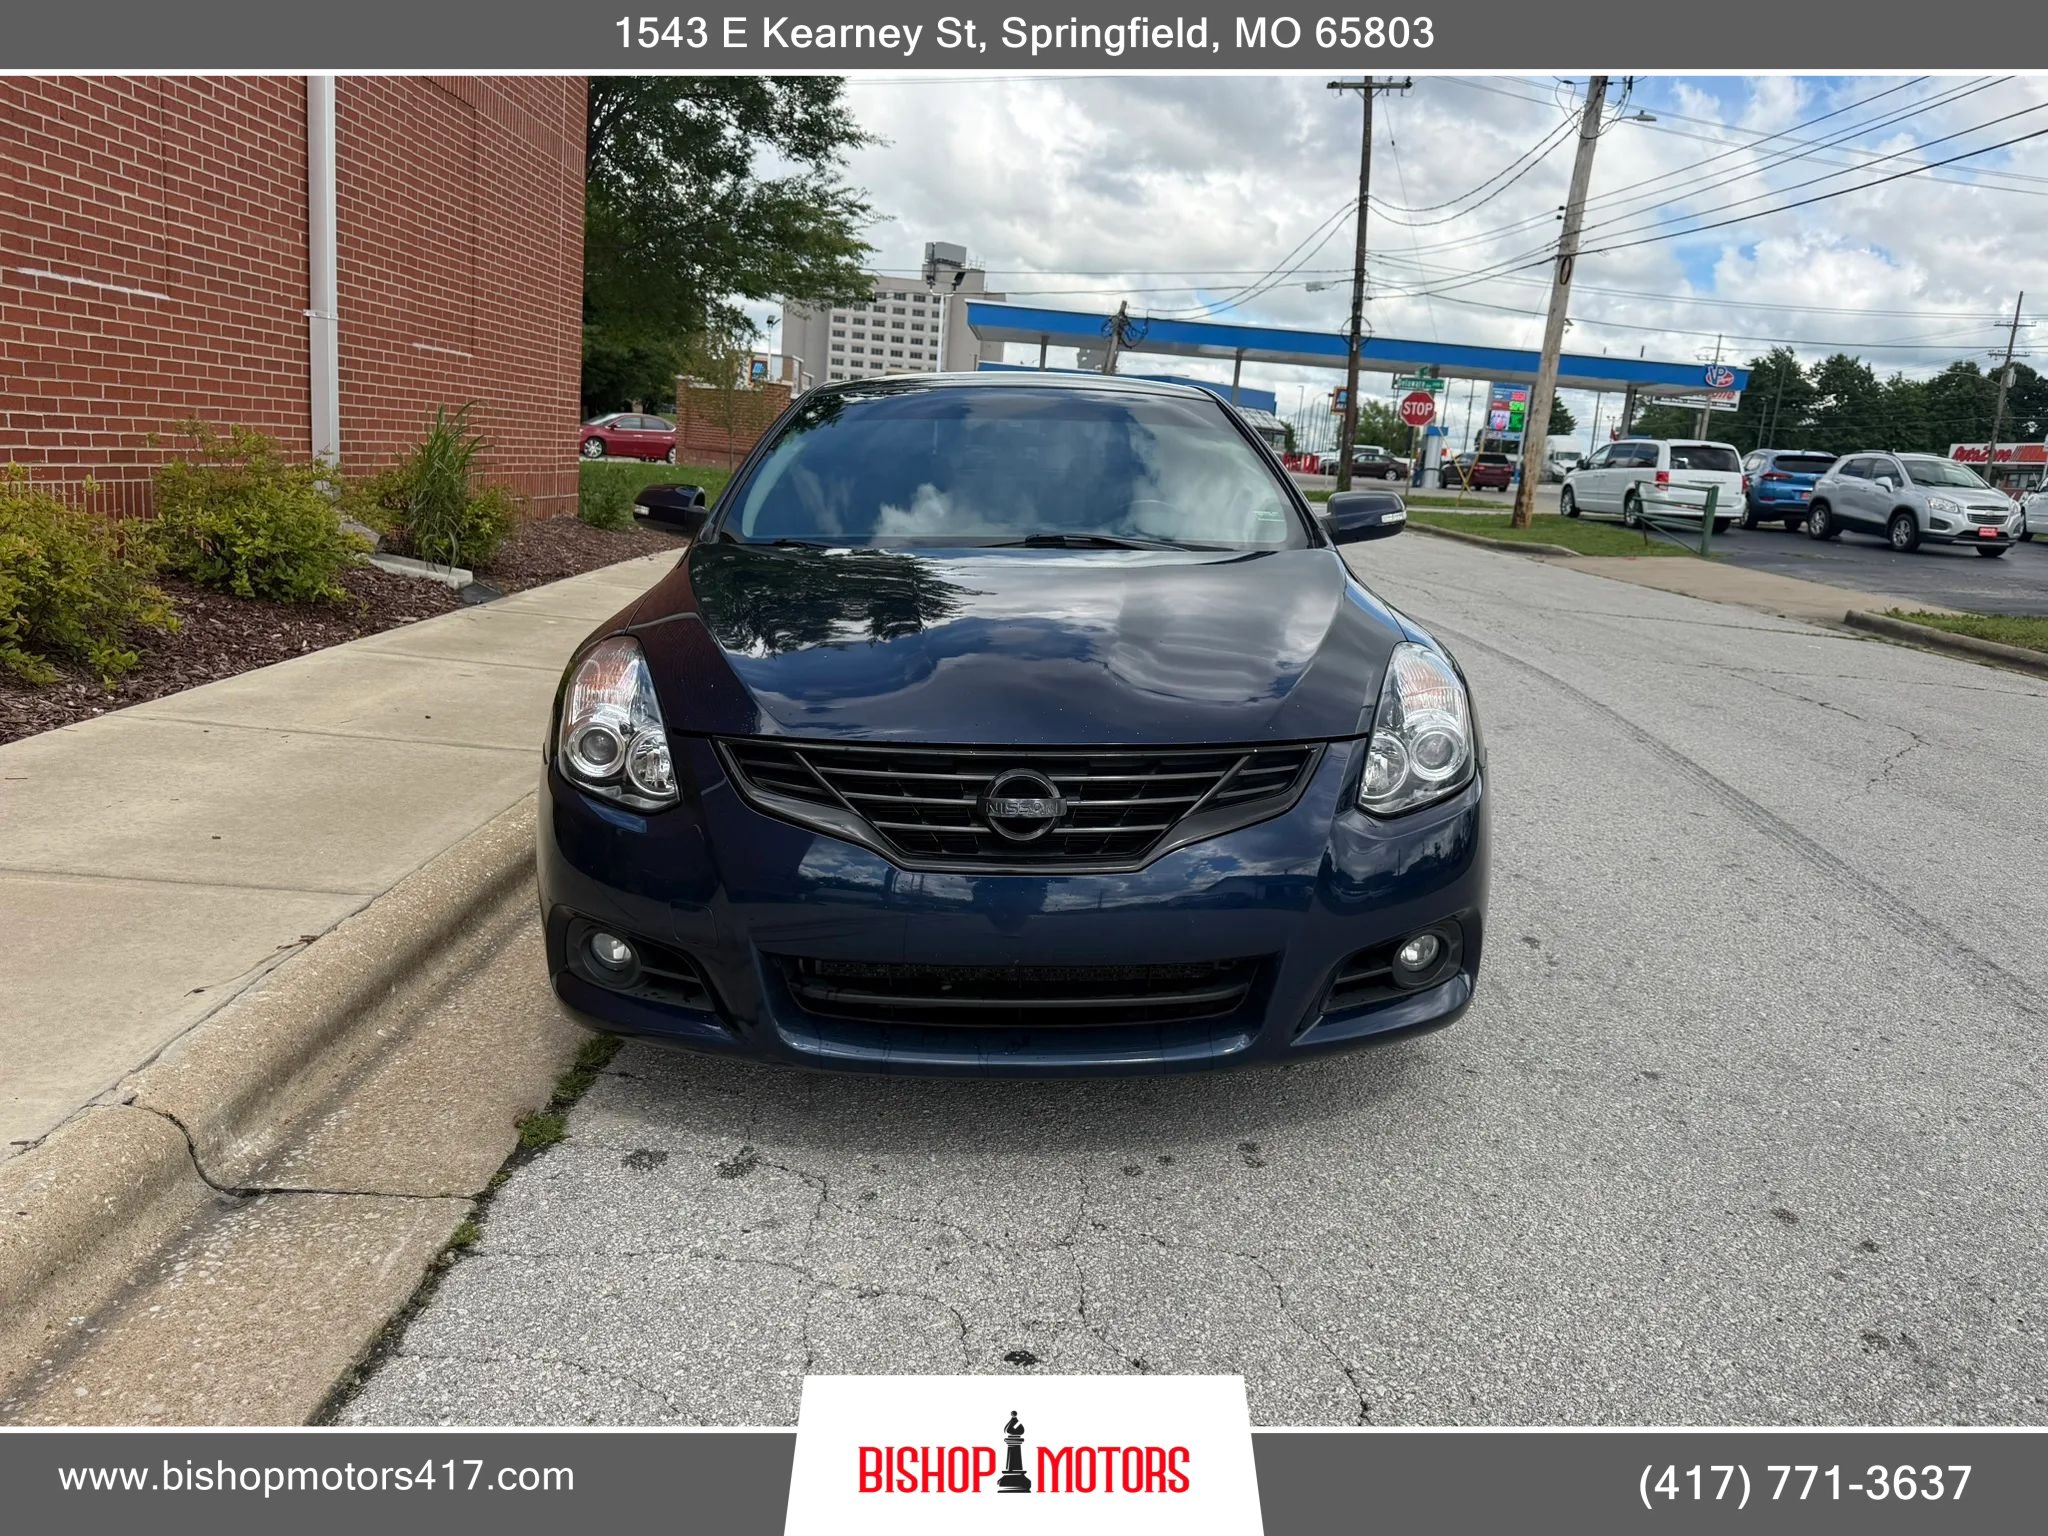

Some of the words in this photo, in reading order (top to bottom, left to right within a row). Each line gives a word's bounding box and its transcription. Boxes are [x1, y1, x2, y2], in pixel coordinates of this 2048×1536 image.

[1402, 401, 1434, 416] STOP
[1952, 445, 2013, 463] AutoZne
[986, 801, 1059, 815] NISSAN
